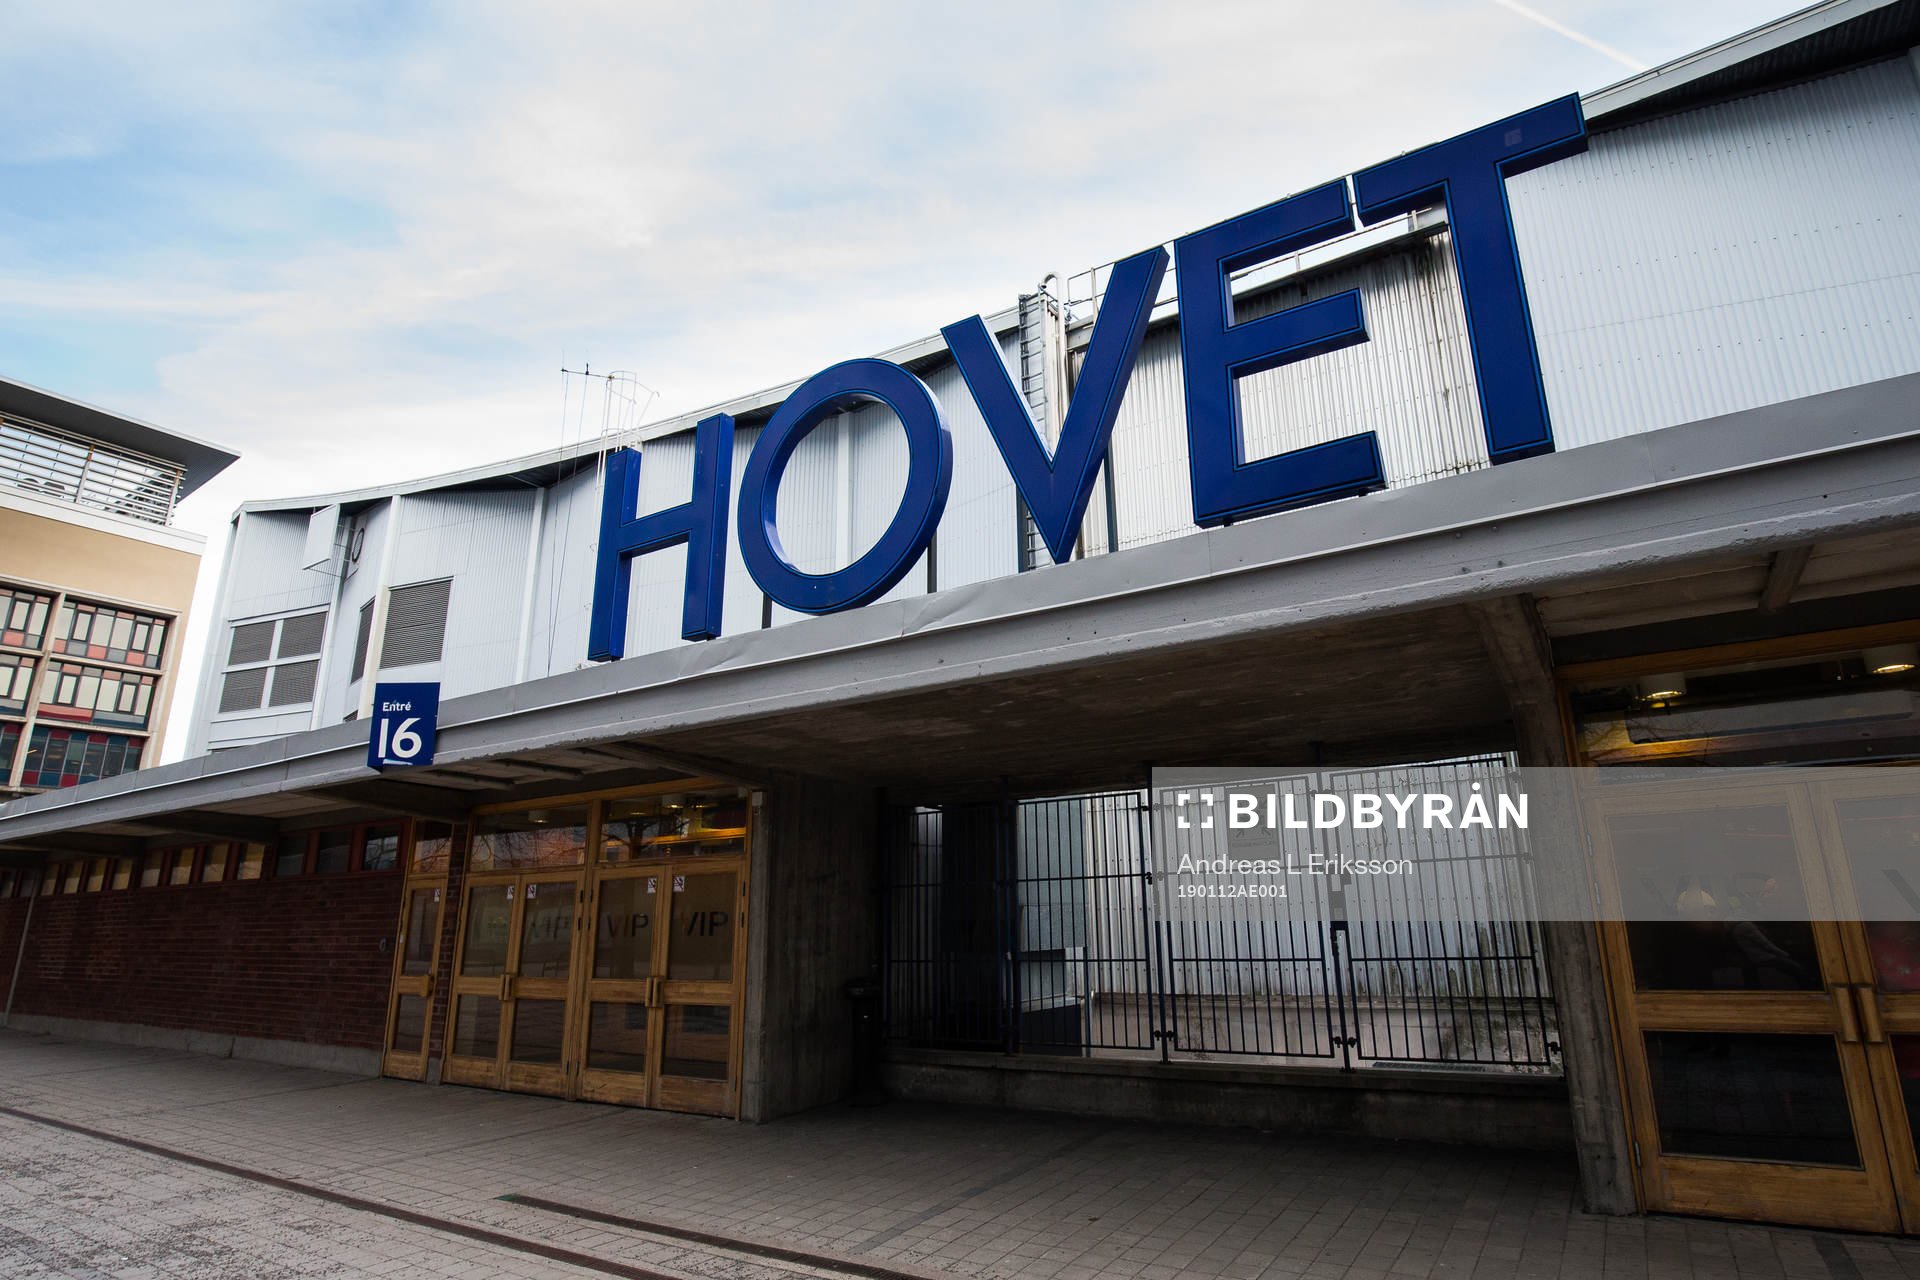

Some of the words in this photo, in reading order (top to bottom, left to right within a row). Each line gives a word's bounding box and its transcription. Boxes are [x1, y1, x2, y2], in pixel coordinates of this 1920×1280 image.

[588, 92, 1588, 662] HOVET
[382, 701, 412, 712] Entré
[377, 717, 422, 759] 16
[606, 913, 648, 937] VIP
[680, 911, 727, 936] VIP
